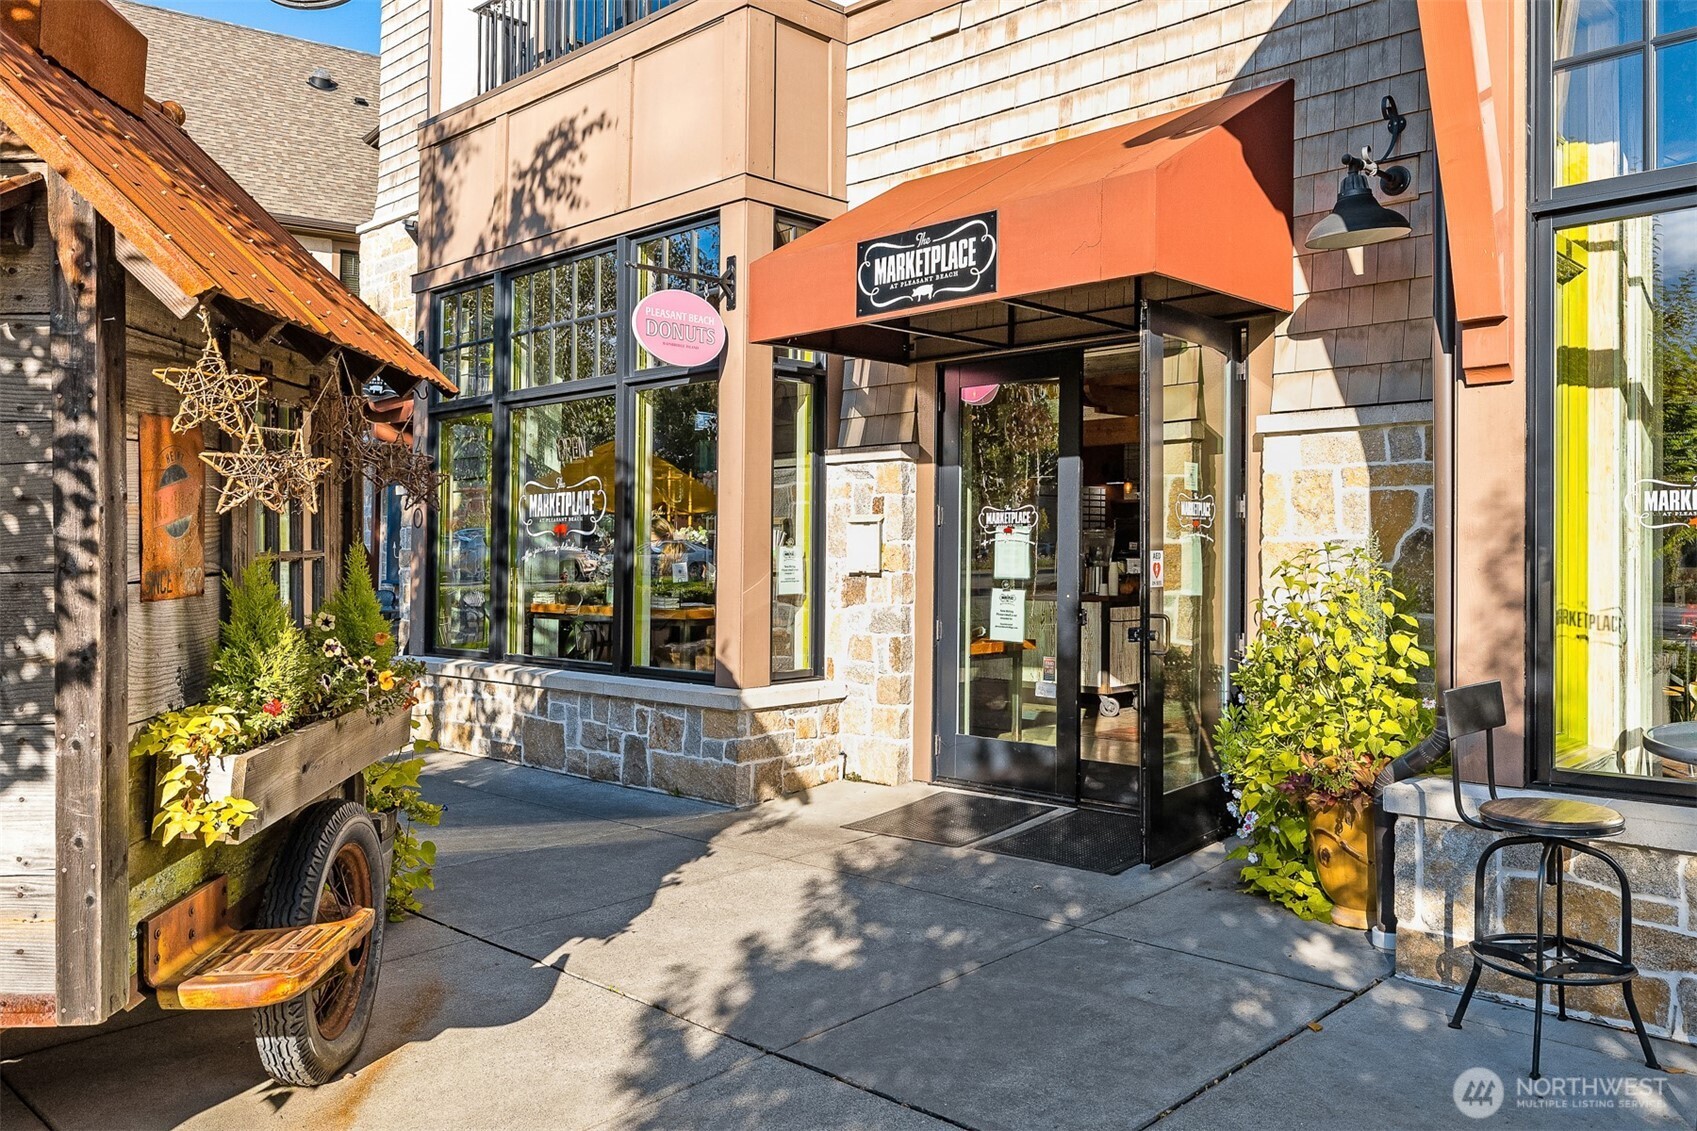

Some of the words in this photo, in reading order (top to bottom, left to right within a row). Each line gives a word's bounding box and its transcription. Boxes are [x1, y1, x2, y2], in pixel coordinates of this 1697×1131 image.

[916, 232, 931, 248] The
[874, 237, 976, 286] MARKETPLACE
[900, 276, 934, 288] PLEASANT
[935, 271, 958, 281] BEACH
[645, 306, 687, 321] PLEASANT
[688, 314, 715, 325] BEACH
[645, 318, 716, 345] DONUTS
[529, 490, 595, 517] MARKETPLACE
[986, 511, 1031, 525] MARKETPLACE
[1152, 552, 1162, 560] AED
